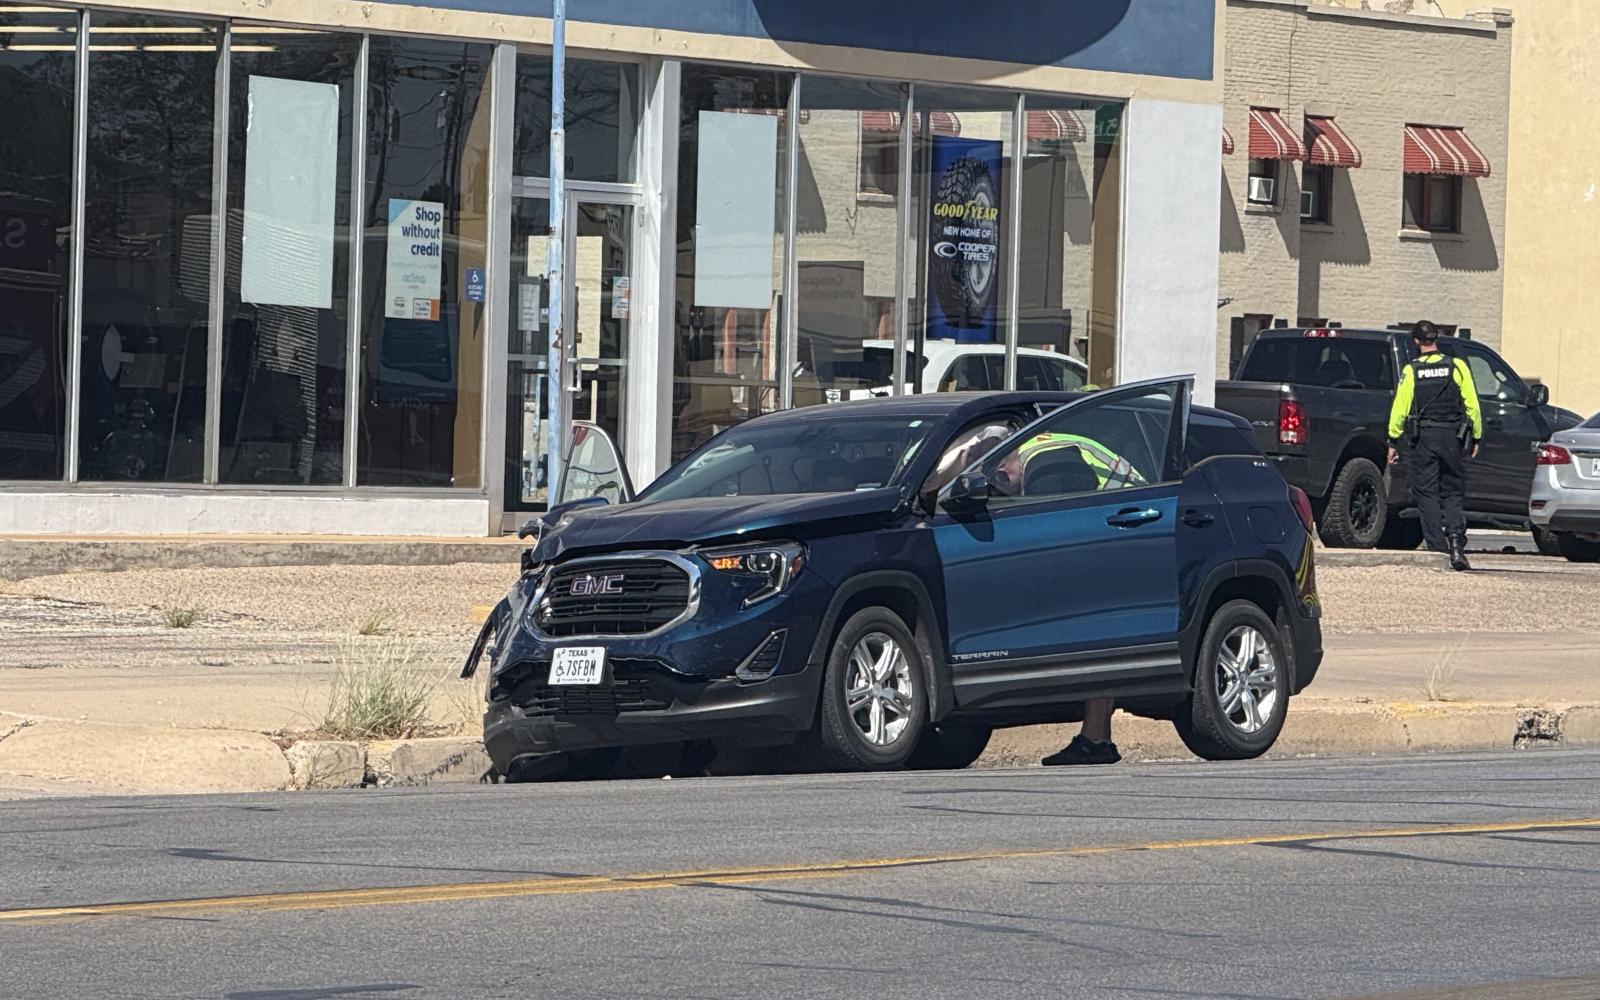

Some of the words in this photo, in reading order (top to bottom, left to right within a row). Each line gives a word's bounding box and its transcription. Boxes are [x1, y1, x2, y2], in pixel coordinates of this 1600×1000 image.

[415, 206, 441, 225] Shop
[933, 200, 998, 221] GOODYEAR
[401, 223, 440, 239] without
[943, 226, 959, 237] NEW
[960, 227, 980, 238] HOME
[982, 229, 992, 239] OF
[411, 242, 440, 257] credit
[958, 241, 996, 253] COOPER
[963, 251, 990, 262] TIRES
[1417, 367, 1450, 379] POLICE
[570, 574, 624, 596] GMC
[568, 649, 588, 657] TEXAS
[951, 650, 1009, 660] TERRAIN
